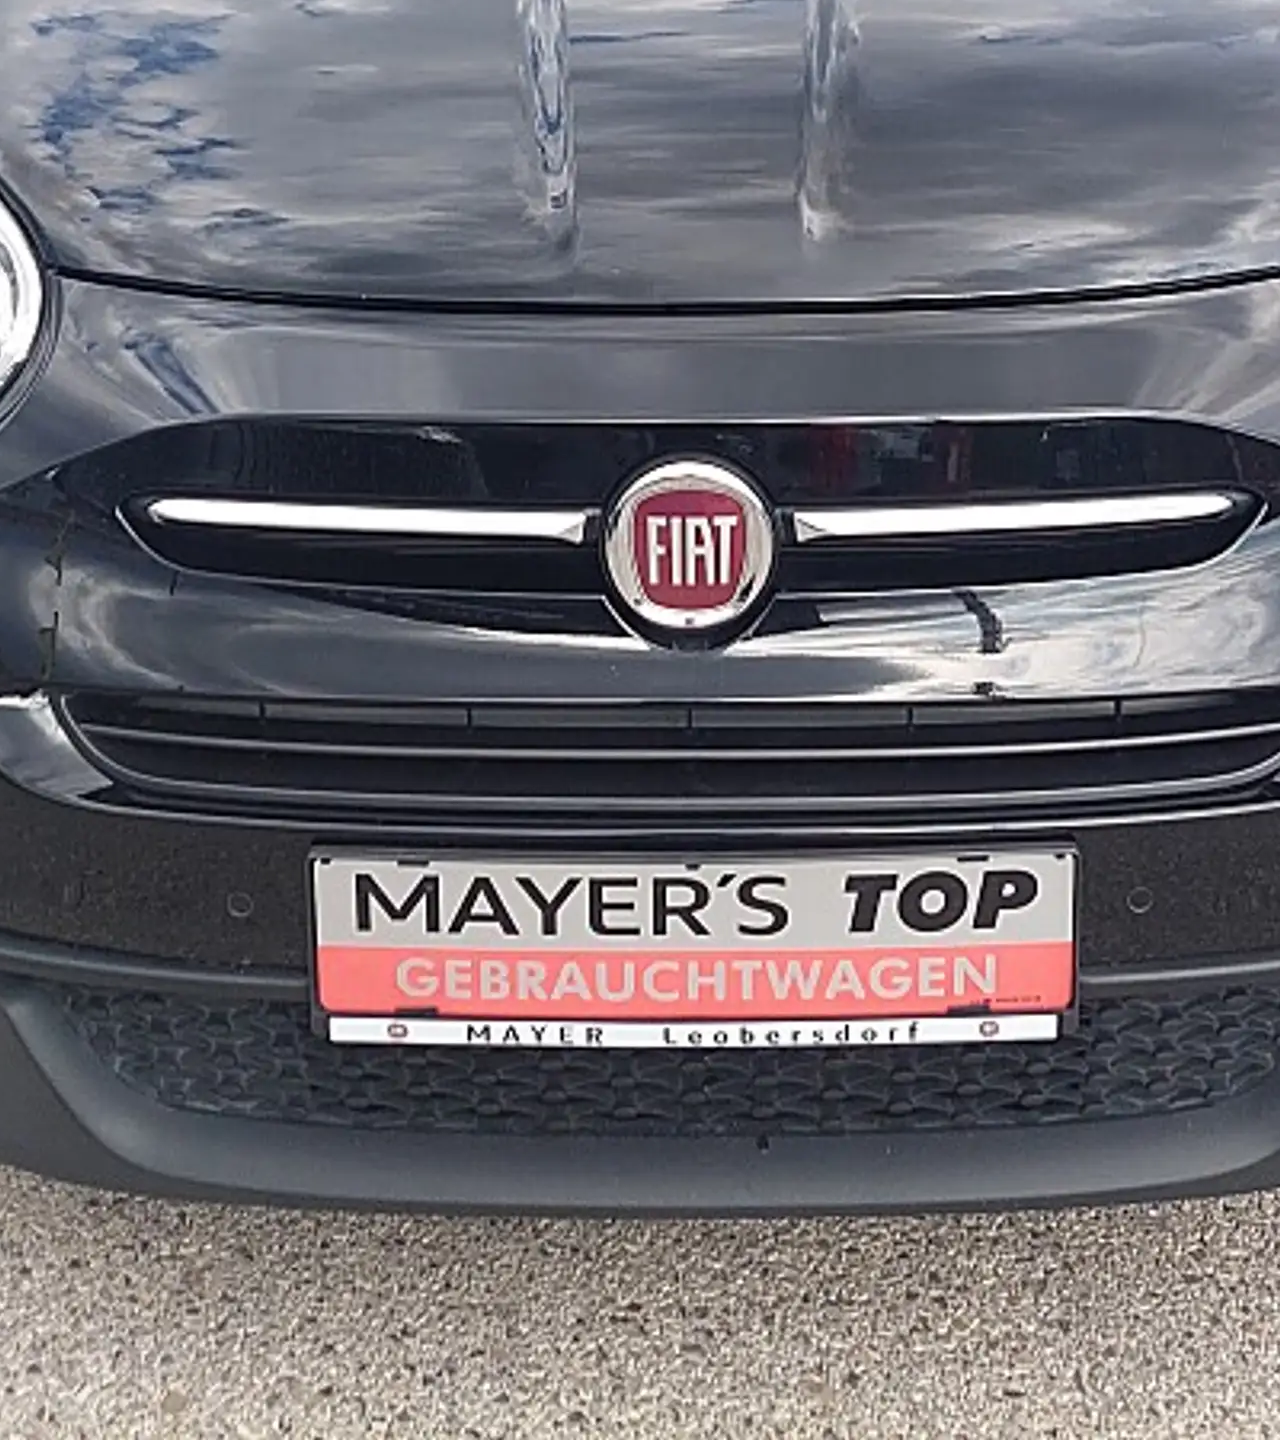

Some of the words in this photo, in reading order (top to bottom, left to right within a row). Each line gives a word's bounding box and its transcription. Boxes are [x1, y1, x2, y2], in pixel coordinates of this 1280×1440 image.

[645, 514, 739, 588] FIAT
[352, 870, 791, 938] MAYER'S
[843, 868, 1041, 934] TOP
[393, 953, 999, 1004] GEBRAUCHTWAGEN
[465, 1024, 606, 1046] MAYER
[662, 1020, 921, 1046] Leobersdorf
